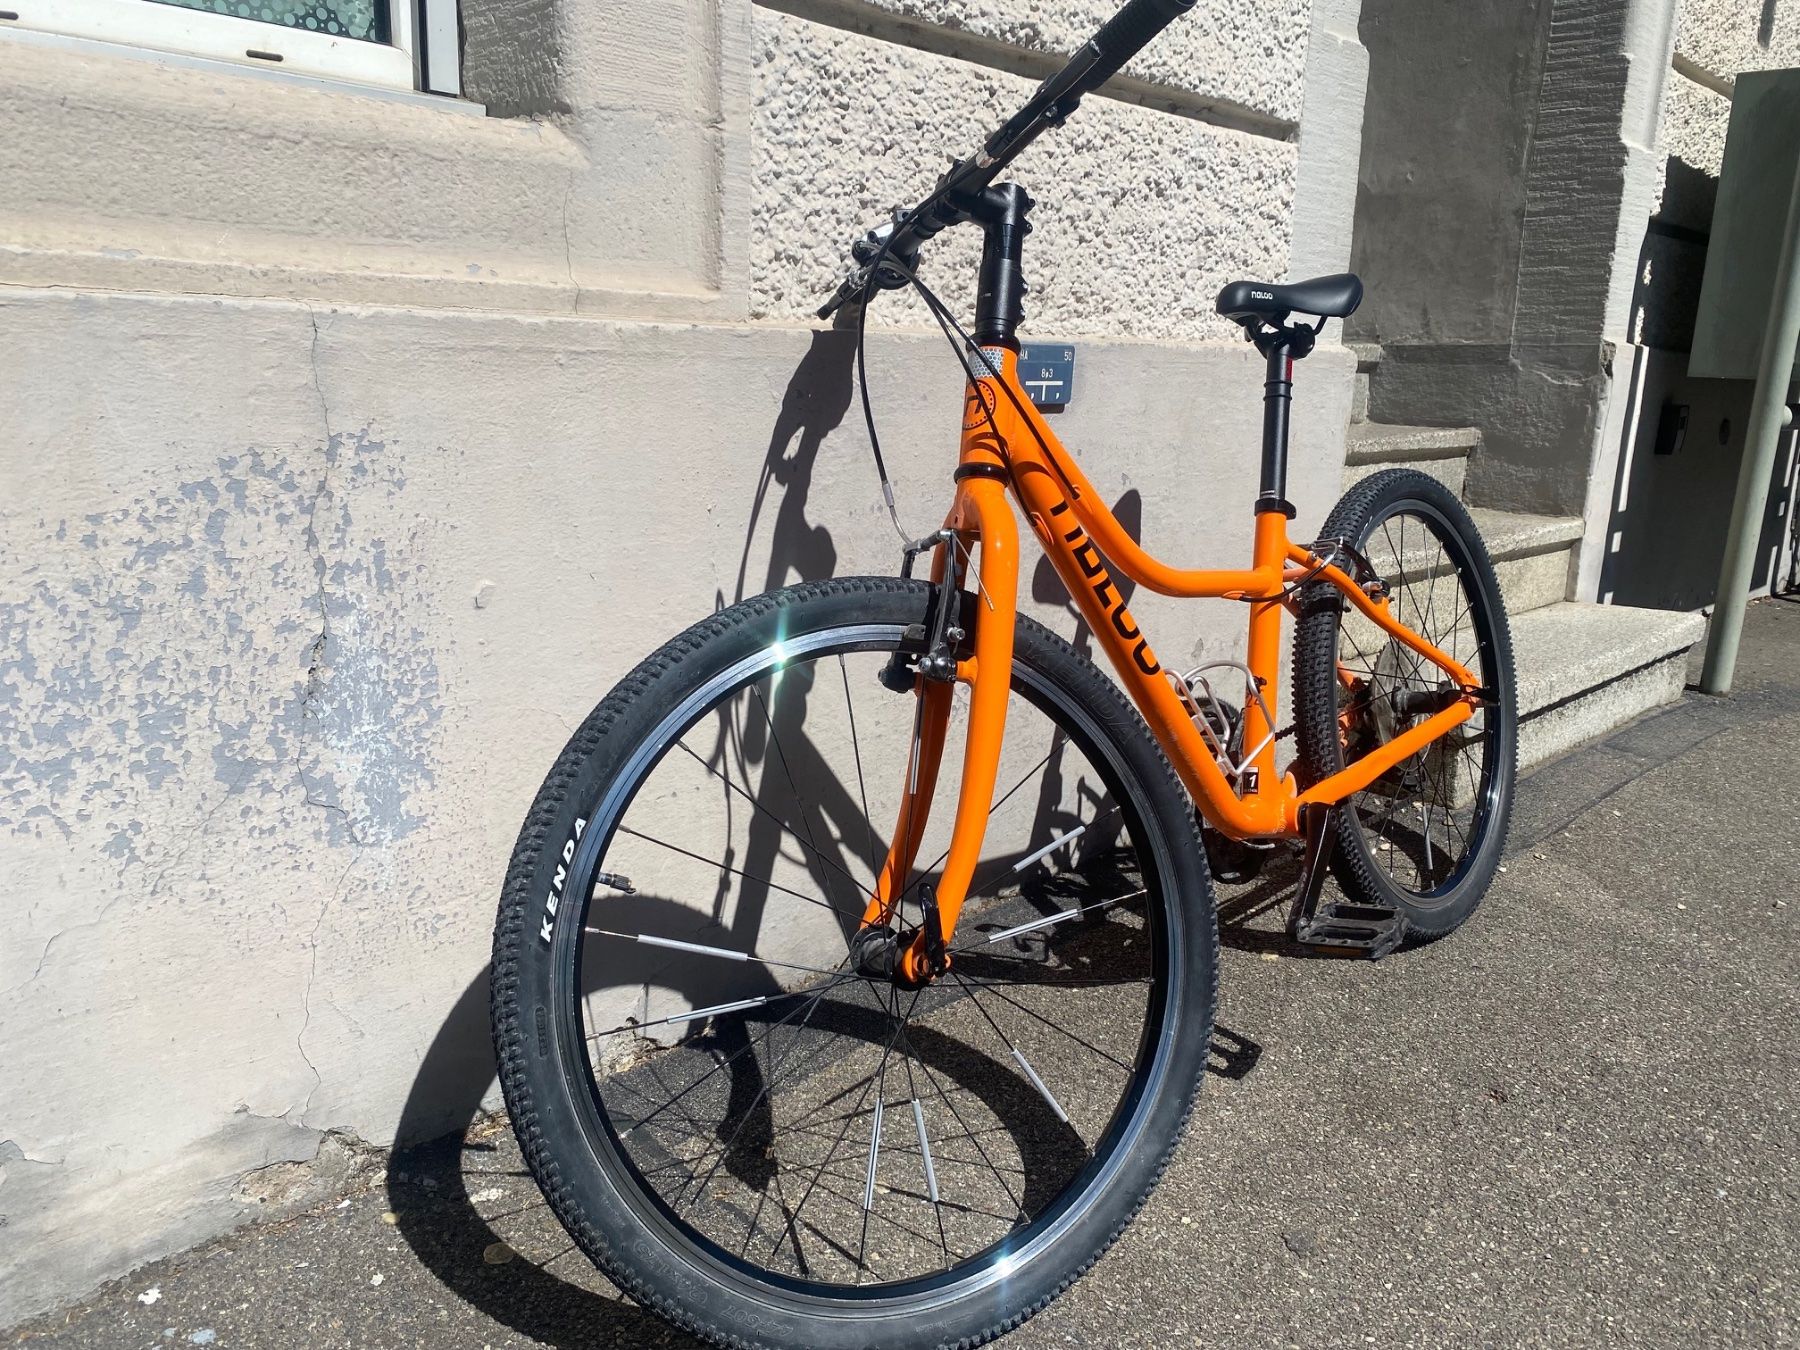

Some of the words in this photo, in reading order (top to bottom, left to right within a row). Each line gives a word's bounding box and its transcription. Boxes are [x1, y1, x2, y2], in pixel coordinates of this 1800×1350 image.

[1064, 351, 1073, 361] 50
[1041, 368, 1054, 379] 8,3
[540, 817, 587, 943] KENDA
